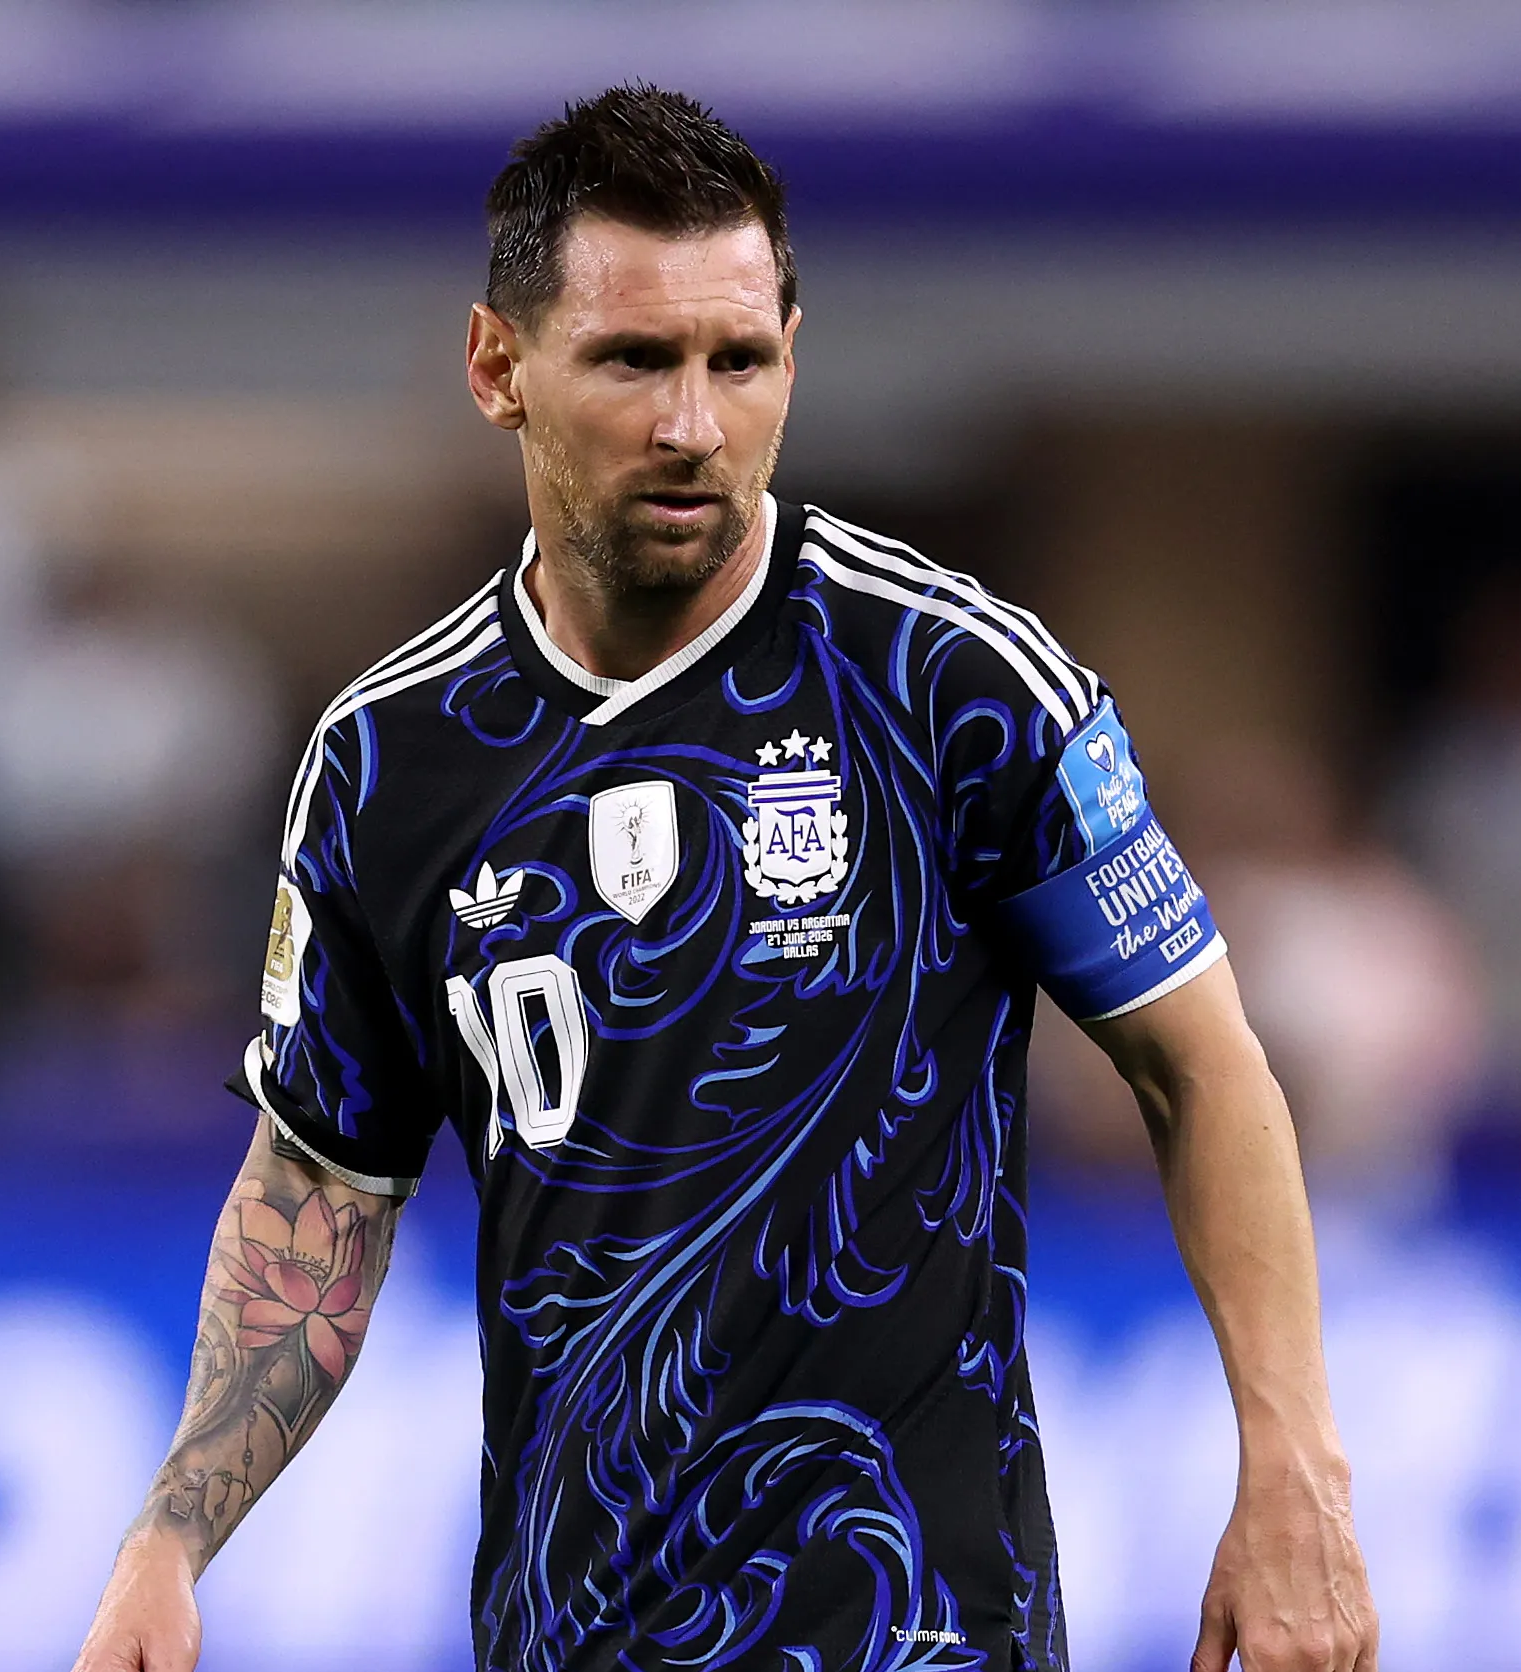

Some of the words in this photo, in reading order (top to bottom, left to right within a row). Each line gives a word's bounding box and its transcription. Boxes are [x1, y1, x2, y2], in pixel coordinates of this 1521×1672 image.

[765, 805, 826, 863] AFA
[1085, 819, 1165, 897] FOOTBALL
[621, 869, 652, 890] FIFA
[1097, 840, 1184, 927] UNITES
[748, 920, 785, 935] JORDAN
[787, 918, 800, 932] VS
[801, 913, 851, 930] ARGENTINA
[1110, 925, 1158, 960] the
[1152, 868, 1203, 931] World
[767, 934, 781, 946] 27
[782, 931, 807, 945] JUNE
[808, 929, 833, 943] 2026
[783, 944, 819, 959] DALLAS
[1163, 922, 1197, 958] FIFA
[445, 954, 590, 1160] 10
[893, 1628, 961, 1645] CLIMACOOL
